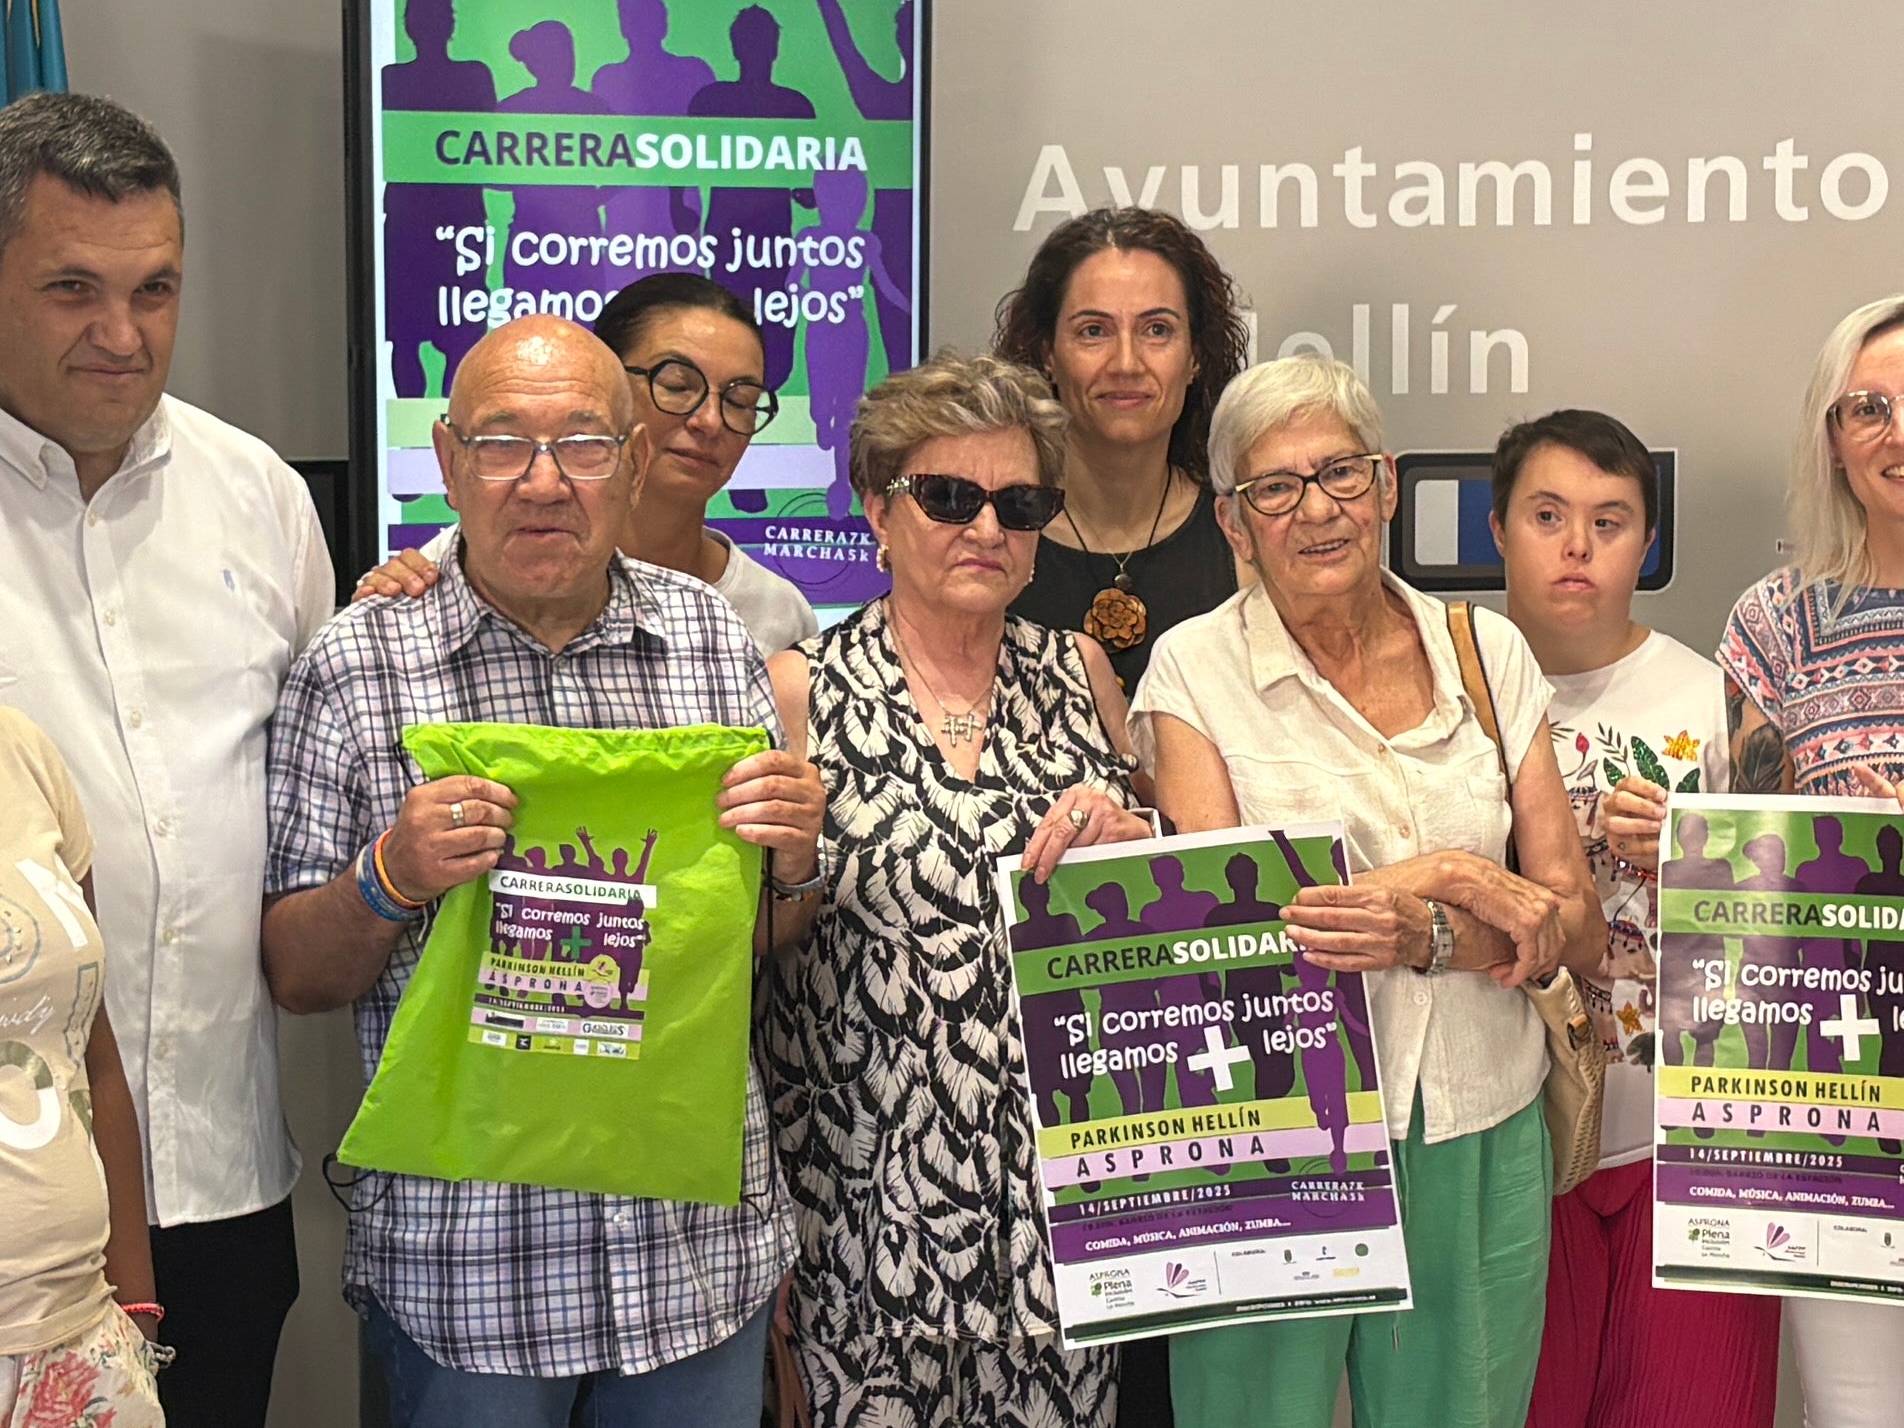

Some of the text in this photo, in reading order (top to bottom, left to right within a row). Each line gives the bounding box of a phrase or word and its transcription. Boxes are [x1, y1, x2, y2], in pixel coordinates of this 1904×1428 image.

[435, 129, 868, 171] CARRERASOLIDARIA
[512, 230, 719, 270] corremos
[725, 227, 866, 272] juntos
[1240, 303, 1529, 394] llín
[500, 875, 641, 901] CARRERASOLIDARIA
[496, 920, 553, 941] llegamos
[521, 907, 591, 926] corremos
[596, 912, 645, 930] juntos
[1047, 930, 1307, 980] CARRERASOLIDAR
[1741, 963, 1871, 992] corremos
[1102, 999, 1235, 1034] corremos
[1241, 990, 1334, 1022] juntos
[1693, 995, 1813, 1025] llegamos
[1060, 1042, 1179, 1079] llegamos
[1691, 1075, 1880, 1102] PARKINSON HELLÍN
[1071, 1107, 1261, 1149] PARKINSON HELLÍN
[1692, 1102, 1880, 1132] ASPRONA
[1076, 1135, 1264, 1178] ASPRONA
[1689, 1147, 1843, 1168] 14/SEPTIEMBRE/2025
[1689, 1186, 1736, 1199] COMIDA,
[1738, 1186, 1782, 1201] MÚSICA,
[1785, 1191, 1849, 1207] ANIMACIÓN,
